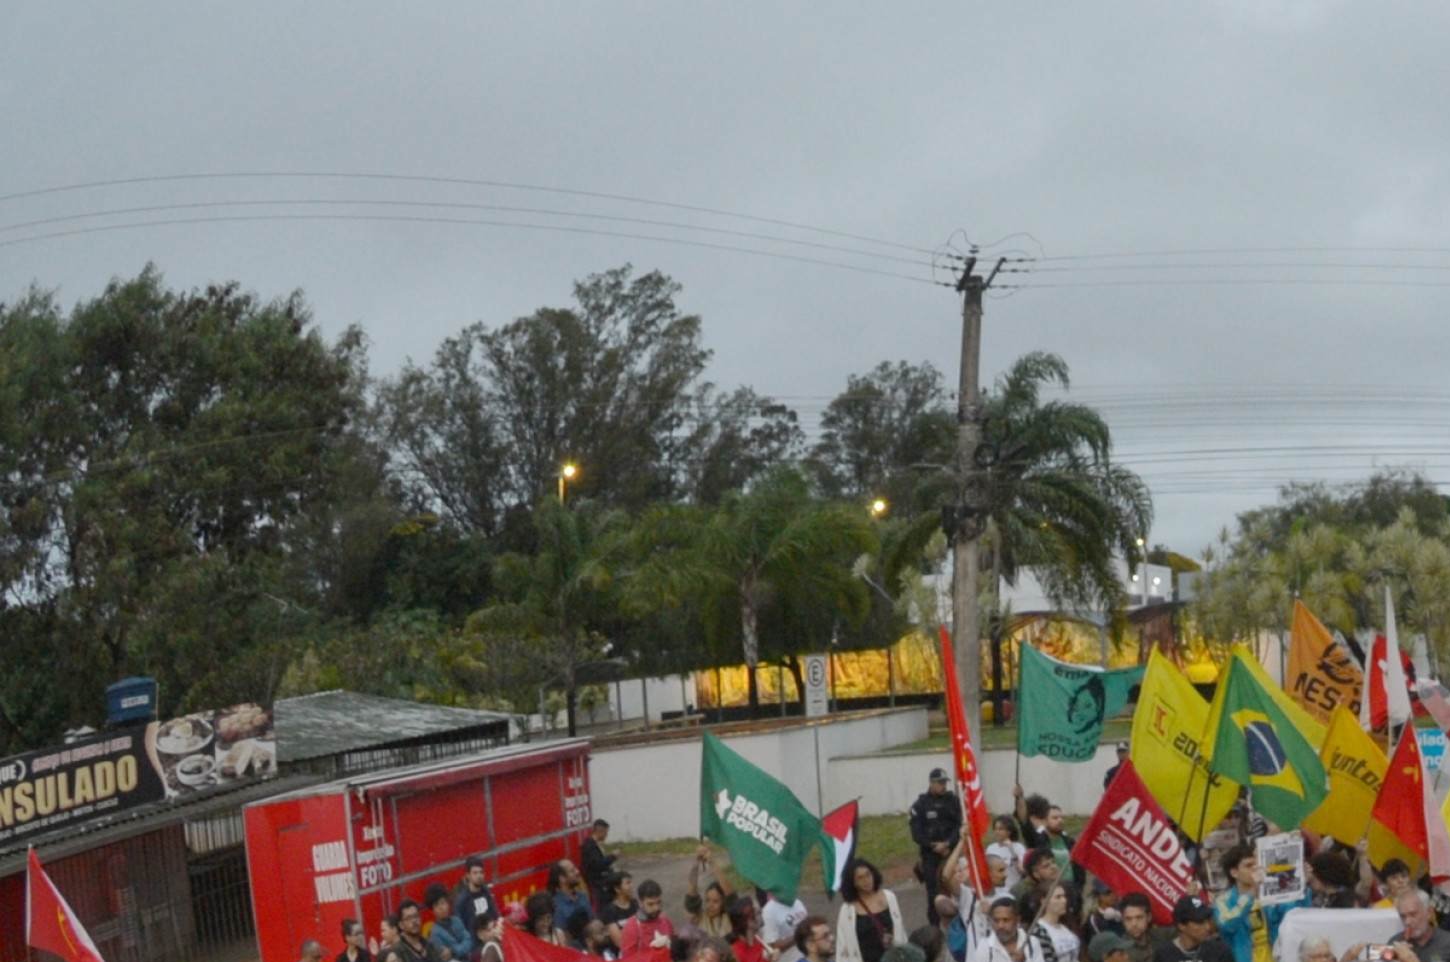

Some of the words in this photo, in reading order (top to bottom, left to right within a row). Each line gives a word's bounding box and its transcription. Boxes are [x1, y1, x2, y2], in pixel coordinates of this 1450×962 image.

[726, 811, 784, 855] POPULAR
[731, 795, 788, 844] BRASIL
[1110, 797, 1193, 882] ANDE
[1097, 830, 1146, 872] SINDICATO
[361, 861, 392, 888] FOTO
